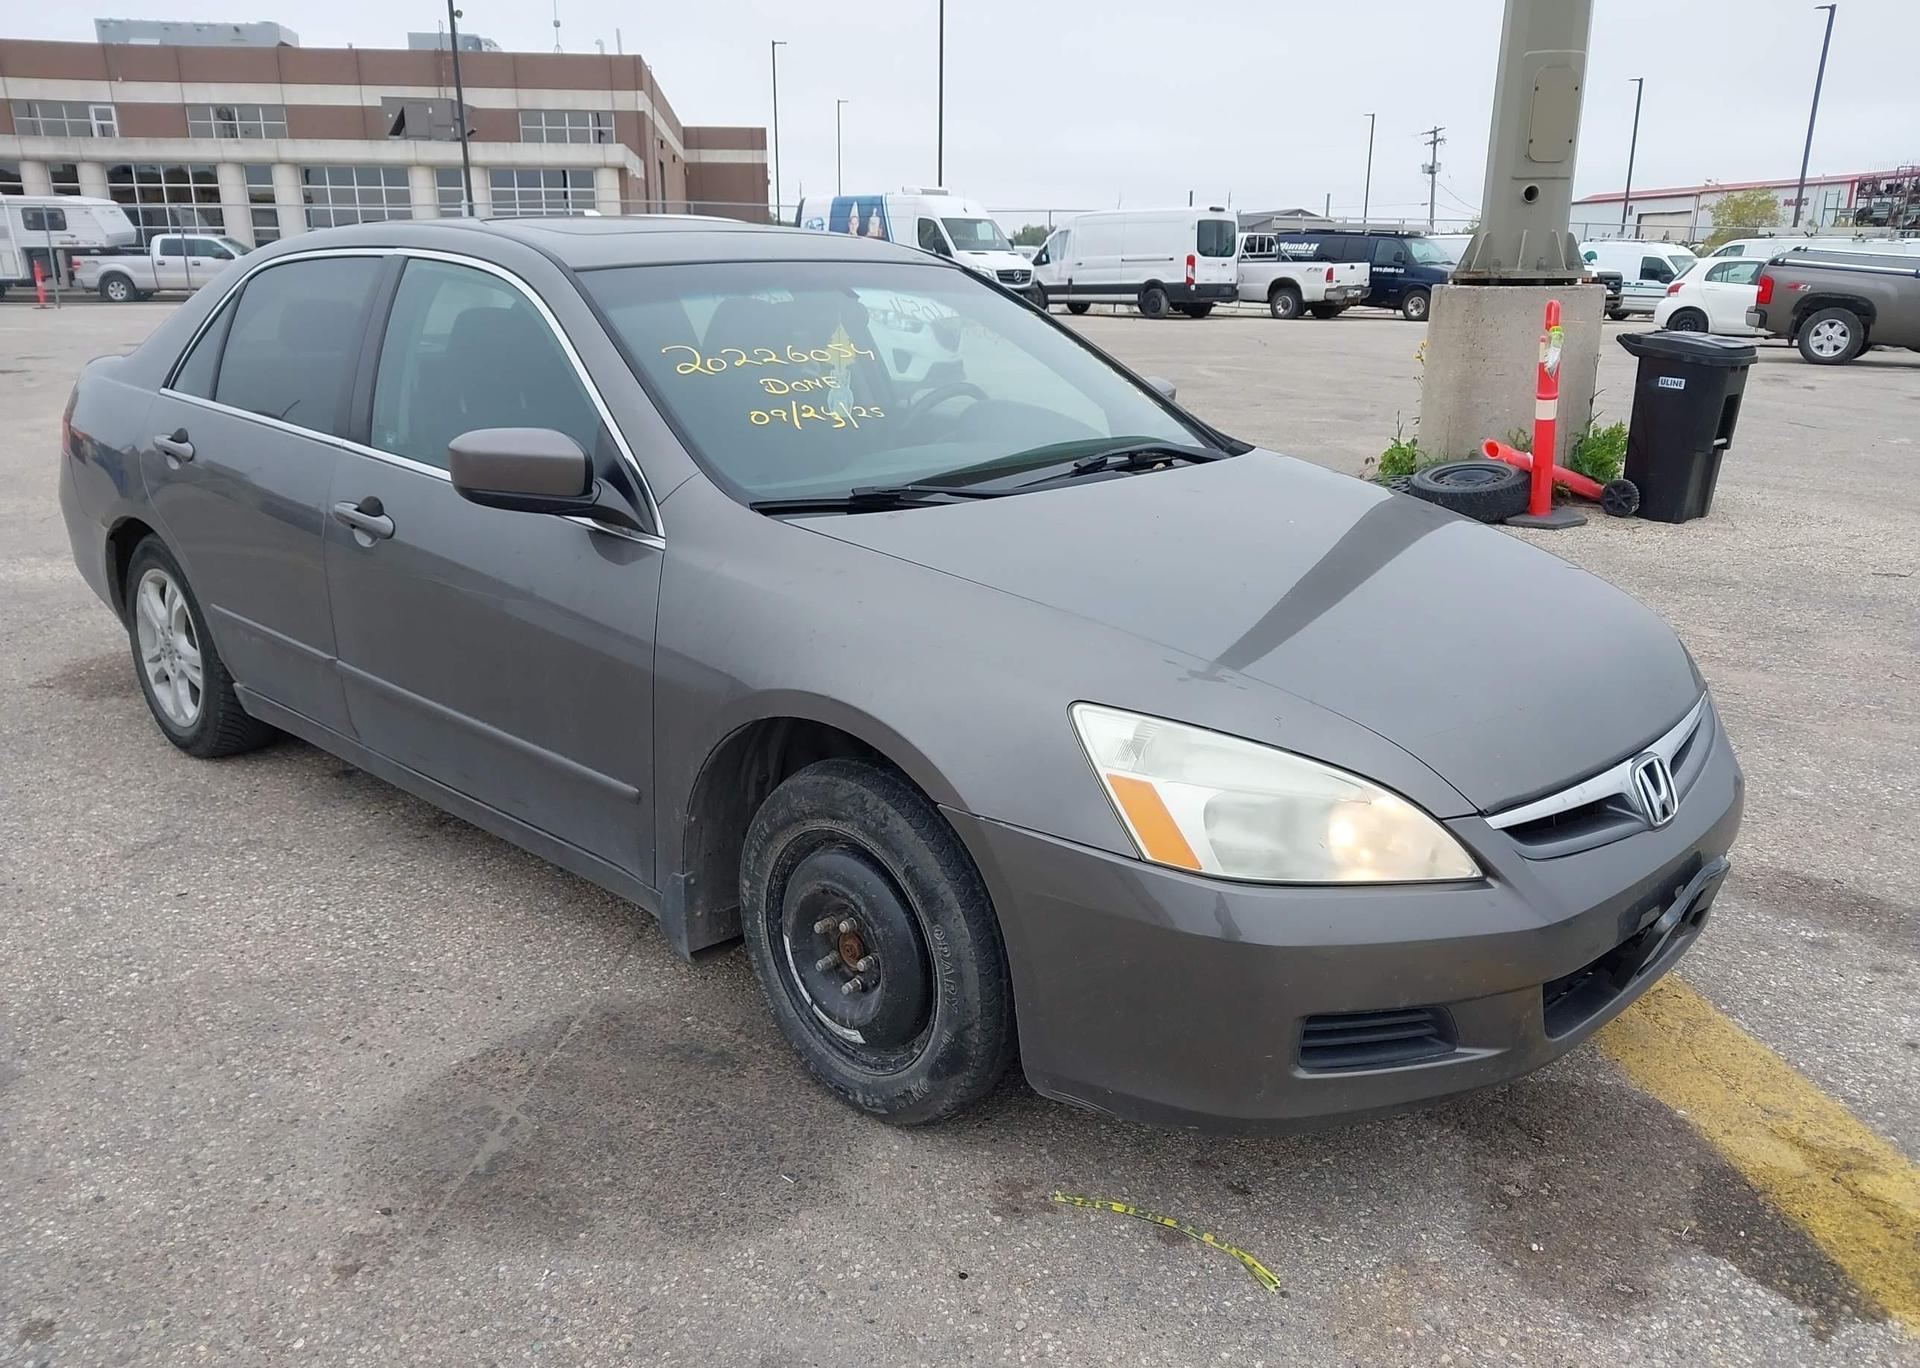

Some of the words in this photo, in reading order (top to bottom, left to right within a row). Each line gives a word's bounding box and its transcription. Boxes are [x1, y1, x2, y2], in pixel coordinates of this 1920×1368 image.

[661, 343, 876, 375] 20226054
[759, 376, 841, 394] DONE
[1660, 377, 1684, 388] ULINE
